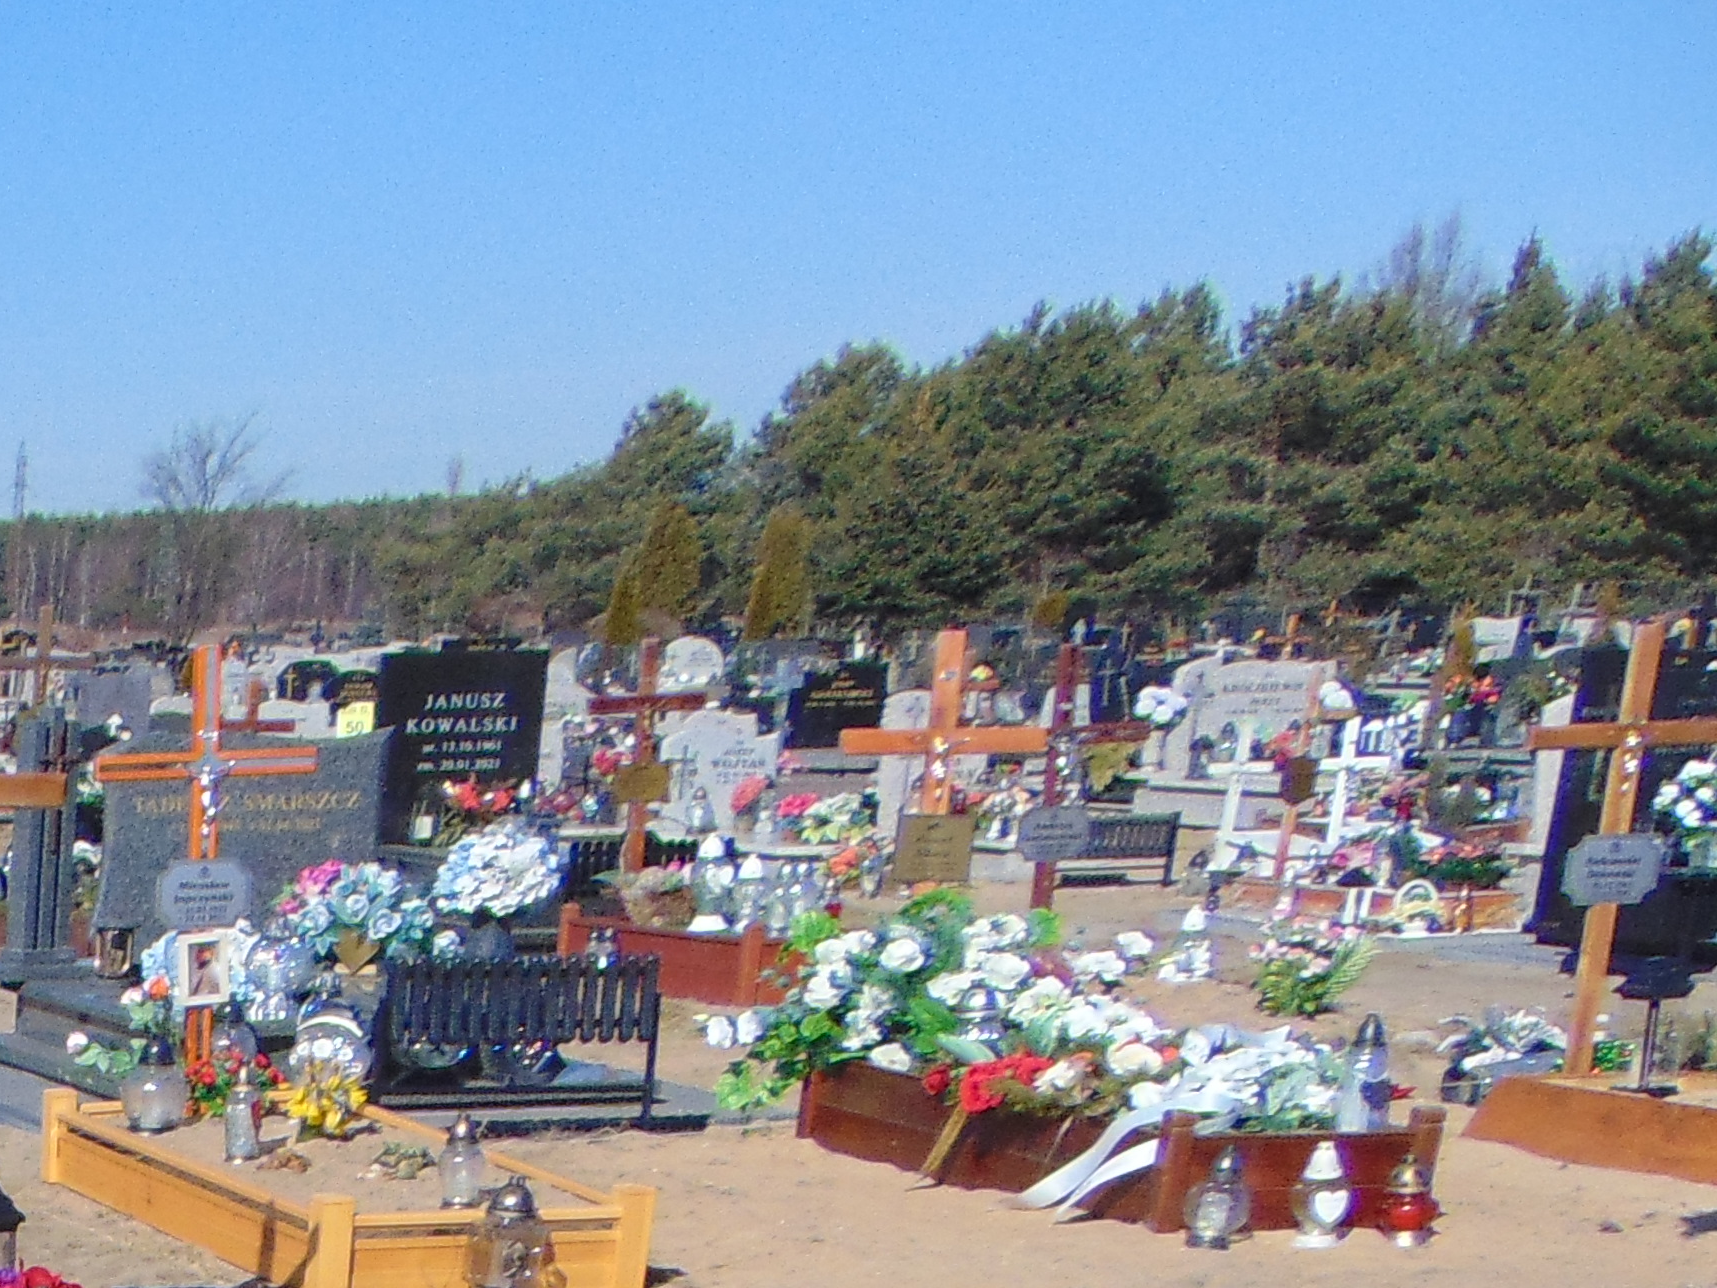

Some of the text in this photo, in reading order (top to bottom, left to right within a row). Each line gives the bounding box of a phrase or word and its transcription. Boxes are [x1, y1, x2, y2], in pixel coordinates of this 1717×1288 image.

[424, 692, 507, 710] JANUSZ
[345, 720, 364, 736] 50
[404, 716, 518, 735] KOWALSKI
